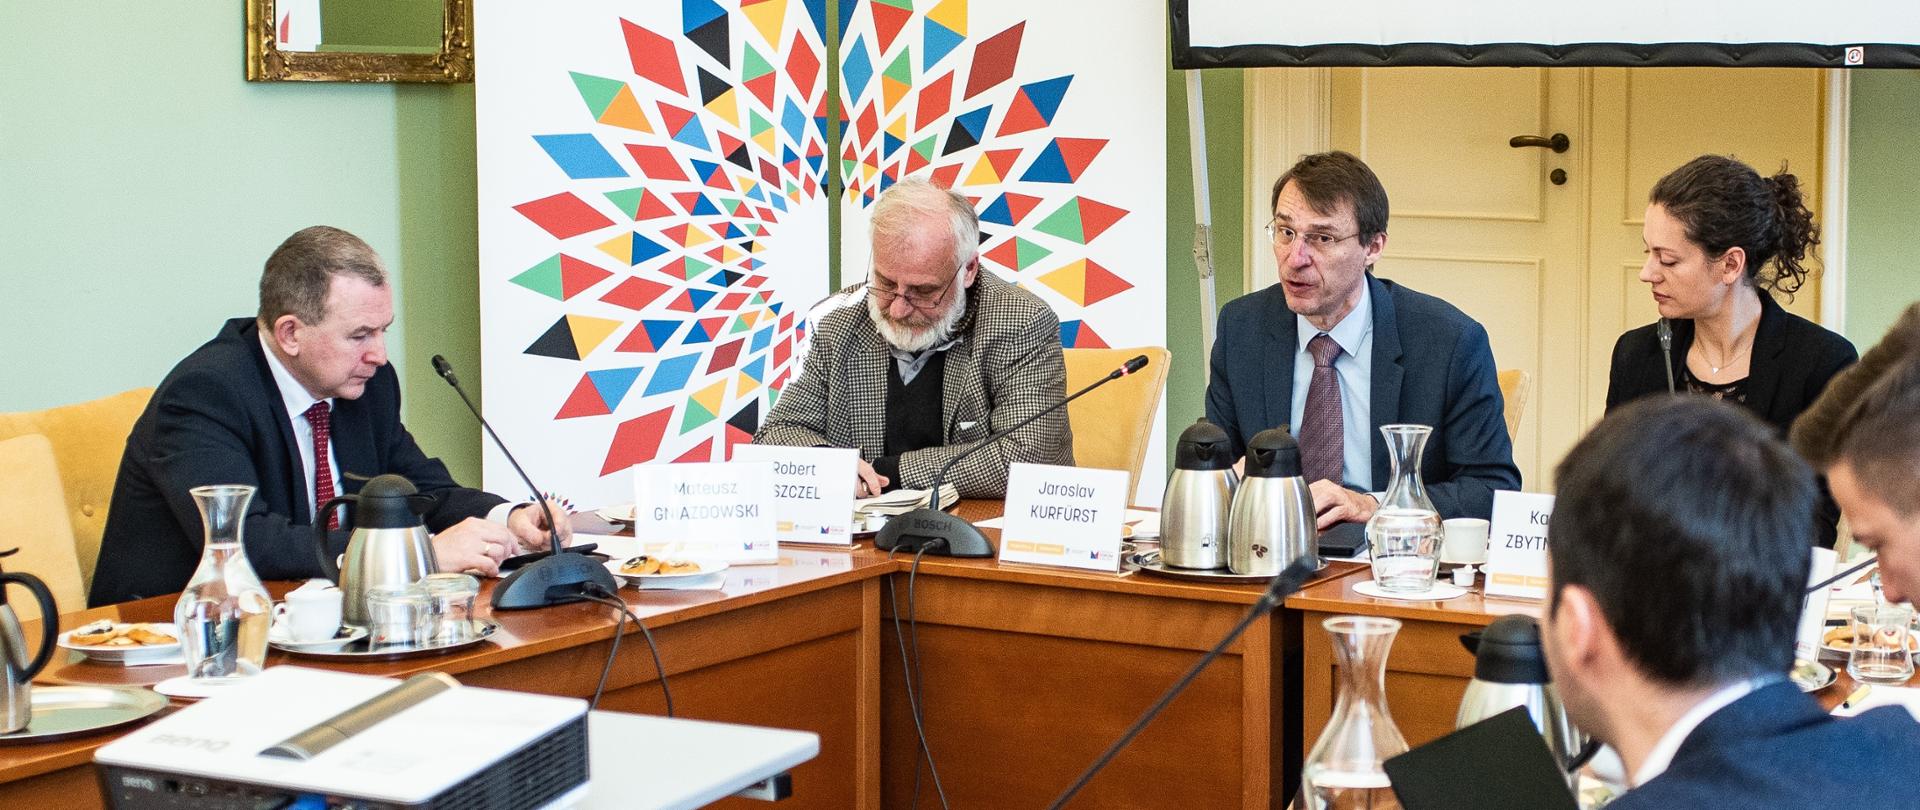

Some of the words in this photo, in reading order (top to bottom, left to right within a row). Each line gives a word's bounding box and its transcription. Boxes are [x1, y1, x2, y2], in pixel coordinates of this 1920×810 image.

[773, 461, 816, 476] Robert
[674, 482, 738, 496] Mateusz
[774, 484, 821, 500] SZCZEL
[1038, 481, 1095, 499] Jaroslav
[1030, 504, 1098, 523] KURFÜRST
[1530, 510, 1549, 526] Ka
[914, 518, 952, 532] BOSCH
[1505, 534, 1549, 551] ZBYTN
